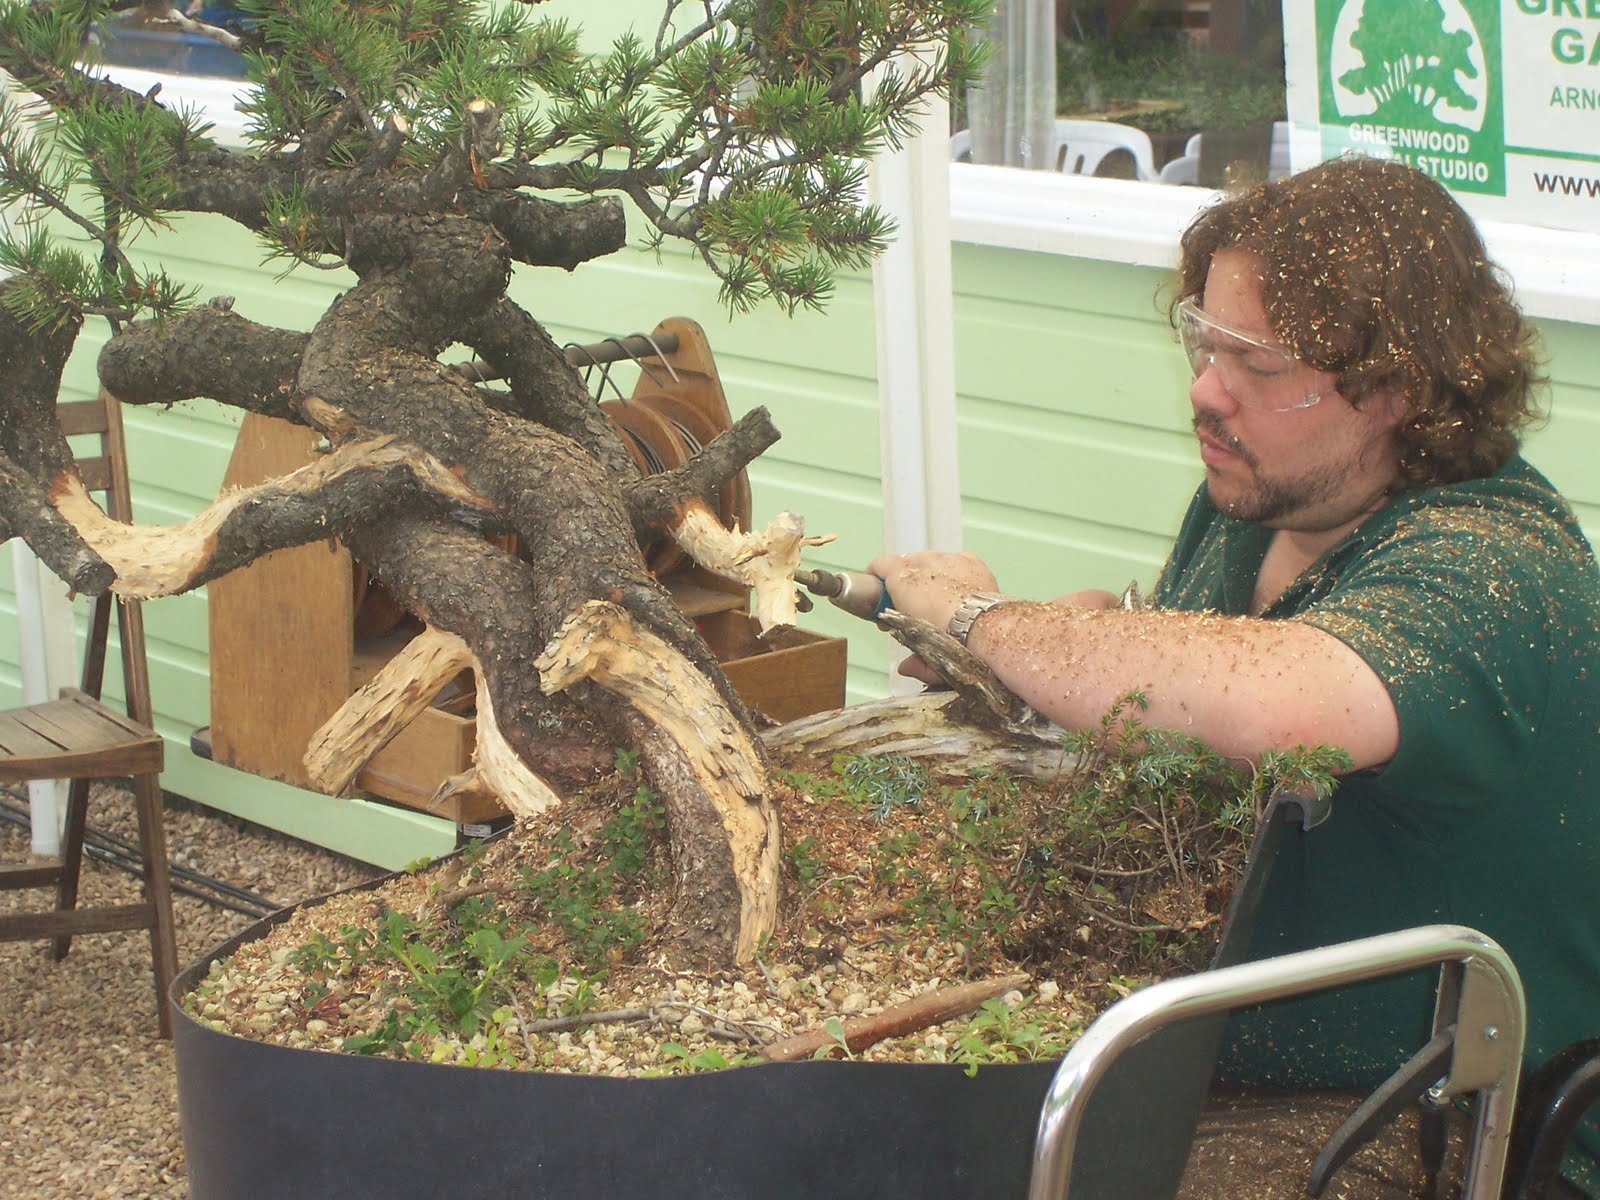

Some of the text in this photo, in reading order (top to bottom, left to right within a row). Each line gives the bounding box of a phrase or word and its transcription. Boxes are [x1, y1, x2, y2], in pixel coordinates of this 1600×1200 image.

[1549, 86, 1600, 110] ARN
[1349, 122, 1470, 154] GREENWOOD
[1417, 155, 1489, 183] STUDIO
